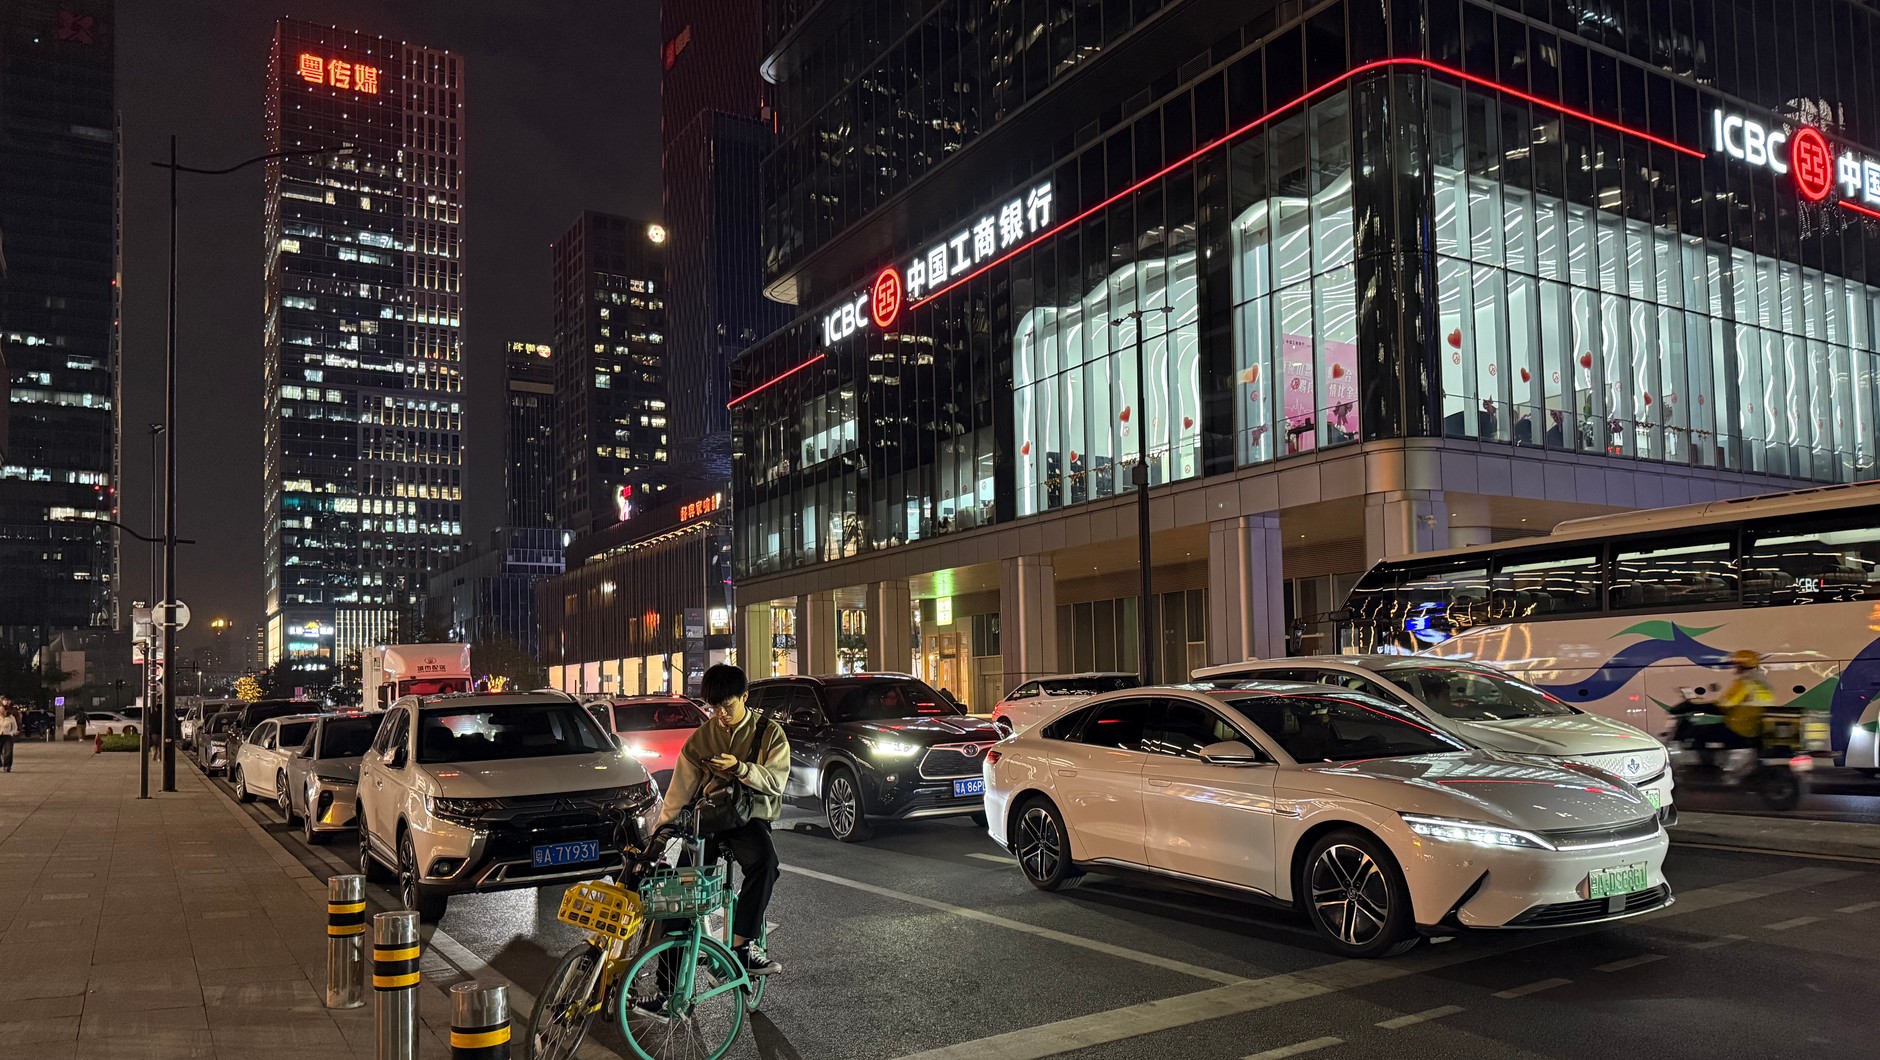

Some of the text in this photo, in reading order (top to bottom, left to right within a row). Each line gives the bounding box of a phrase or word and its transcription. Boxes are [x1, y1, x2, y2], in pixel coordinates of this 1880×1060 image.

[300, 53, 378, 95] 粤传媒
[1713, 108, 1788, 174] ICBC
[906, 180, 1053, 298] 中国工商银行
[823, 294, 869, 347] ICBC
